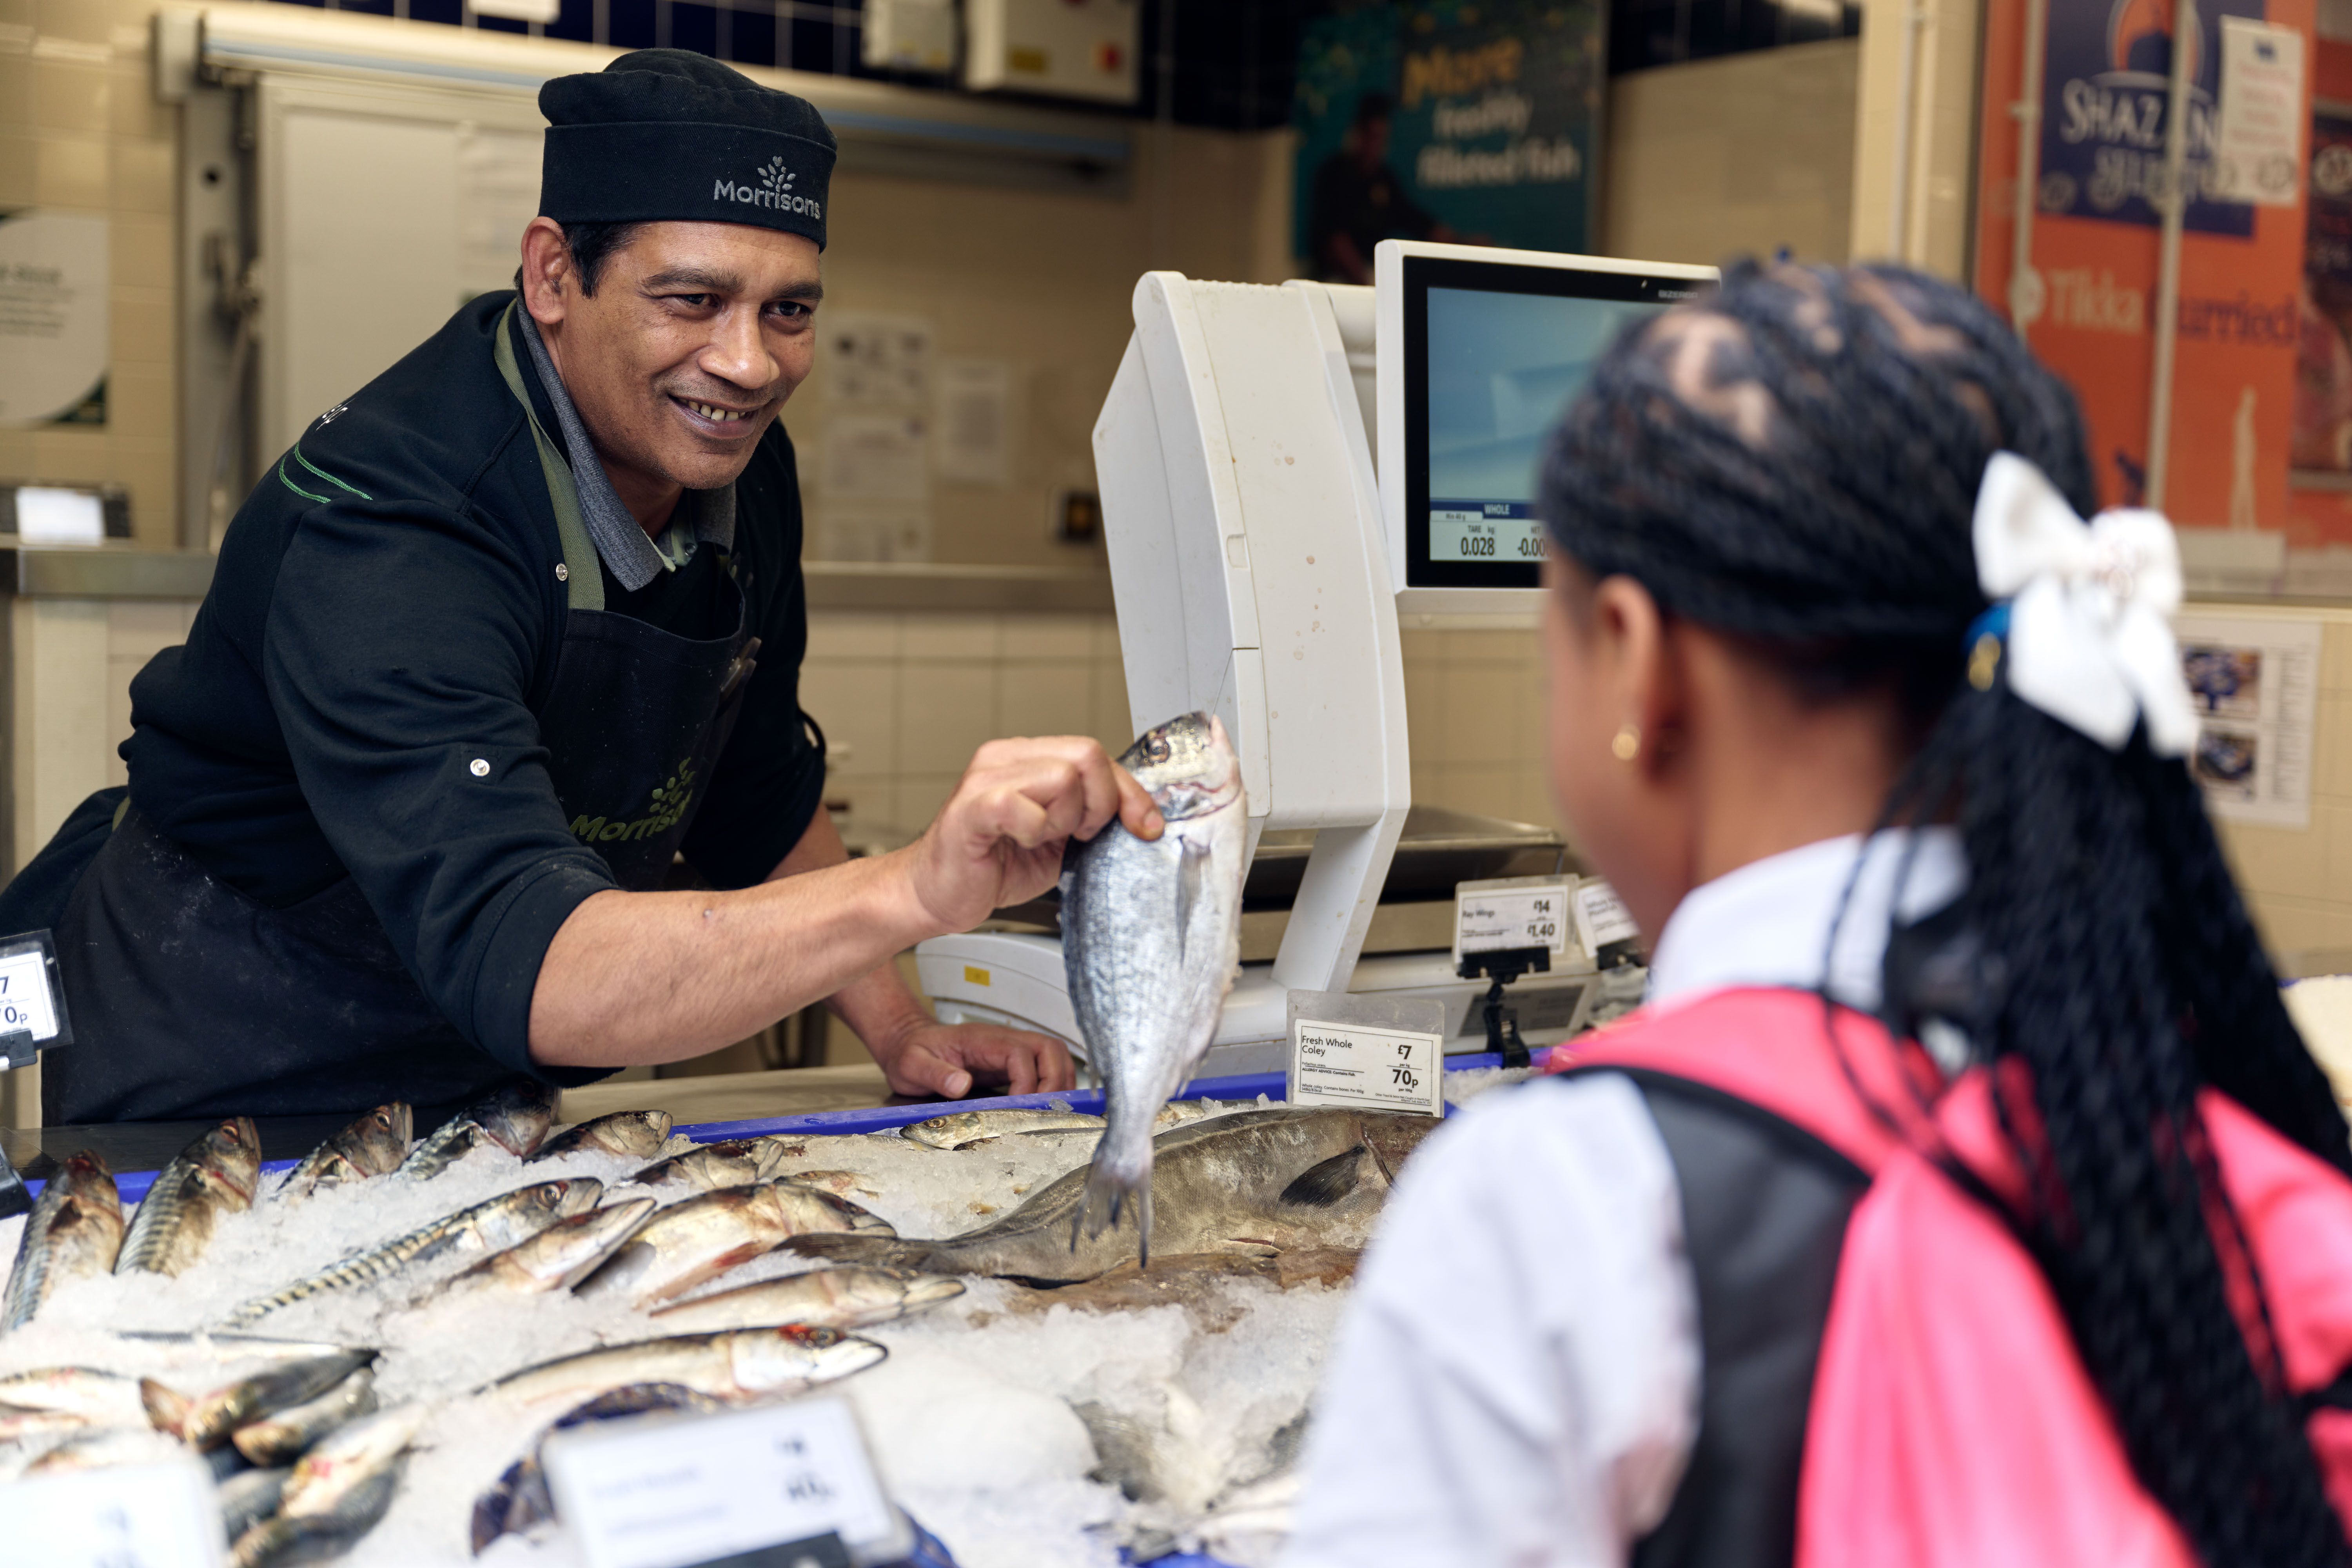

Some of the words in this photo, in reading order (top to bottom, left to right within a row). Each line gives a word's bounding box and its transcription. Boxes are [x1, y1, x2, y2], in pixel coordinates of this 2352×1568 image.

[713, 179, 821, 220] Morrisons
[1484, 504, 1510, 515] WHOLE
[1488, 525, 1494, 535] kg
[1461, 536, 1495, 556] 0.028
[1533, 899, 1550, 913] £14
[1463, 910, 1474, 918] Ray
[1475, 909, 1495, 918] Wings
[1527, 922, 1555, 937] £1.40
[1302, 1035, 1323, 1045] Fresh
[1326, 1038, 1352, 1049] Whole
[1302, 1045, 1325, 1057] Coley
[1397, 1044, 1412, 1060] £7
[1392, 1069, 1418, 1088] 70p
